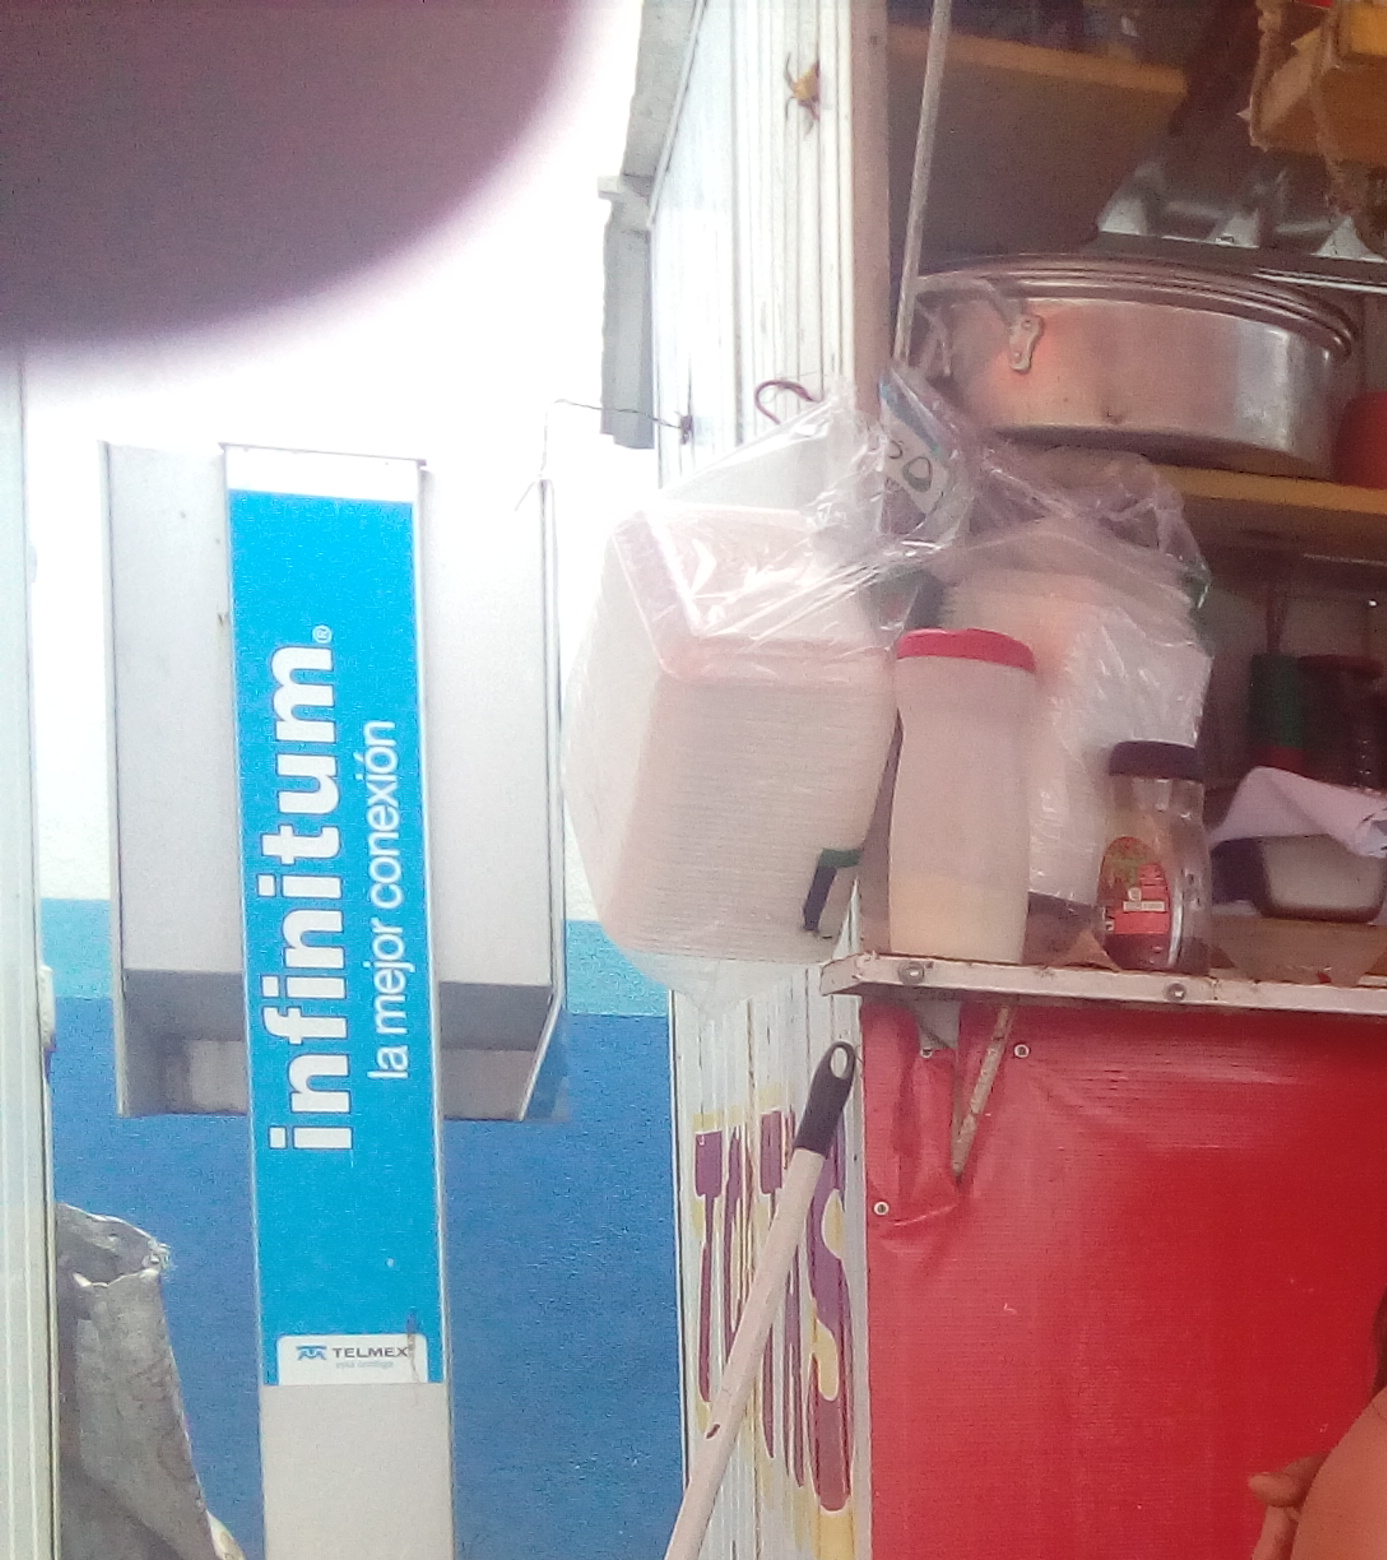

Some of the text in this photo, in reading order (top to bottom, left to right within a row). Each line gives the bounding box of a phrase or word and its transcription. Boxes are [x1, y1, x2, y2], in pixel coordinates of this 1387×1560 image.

[354, 720, 416, 1079] la mejor conexión
[332, 1346, 409, 1358] TELMEX
